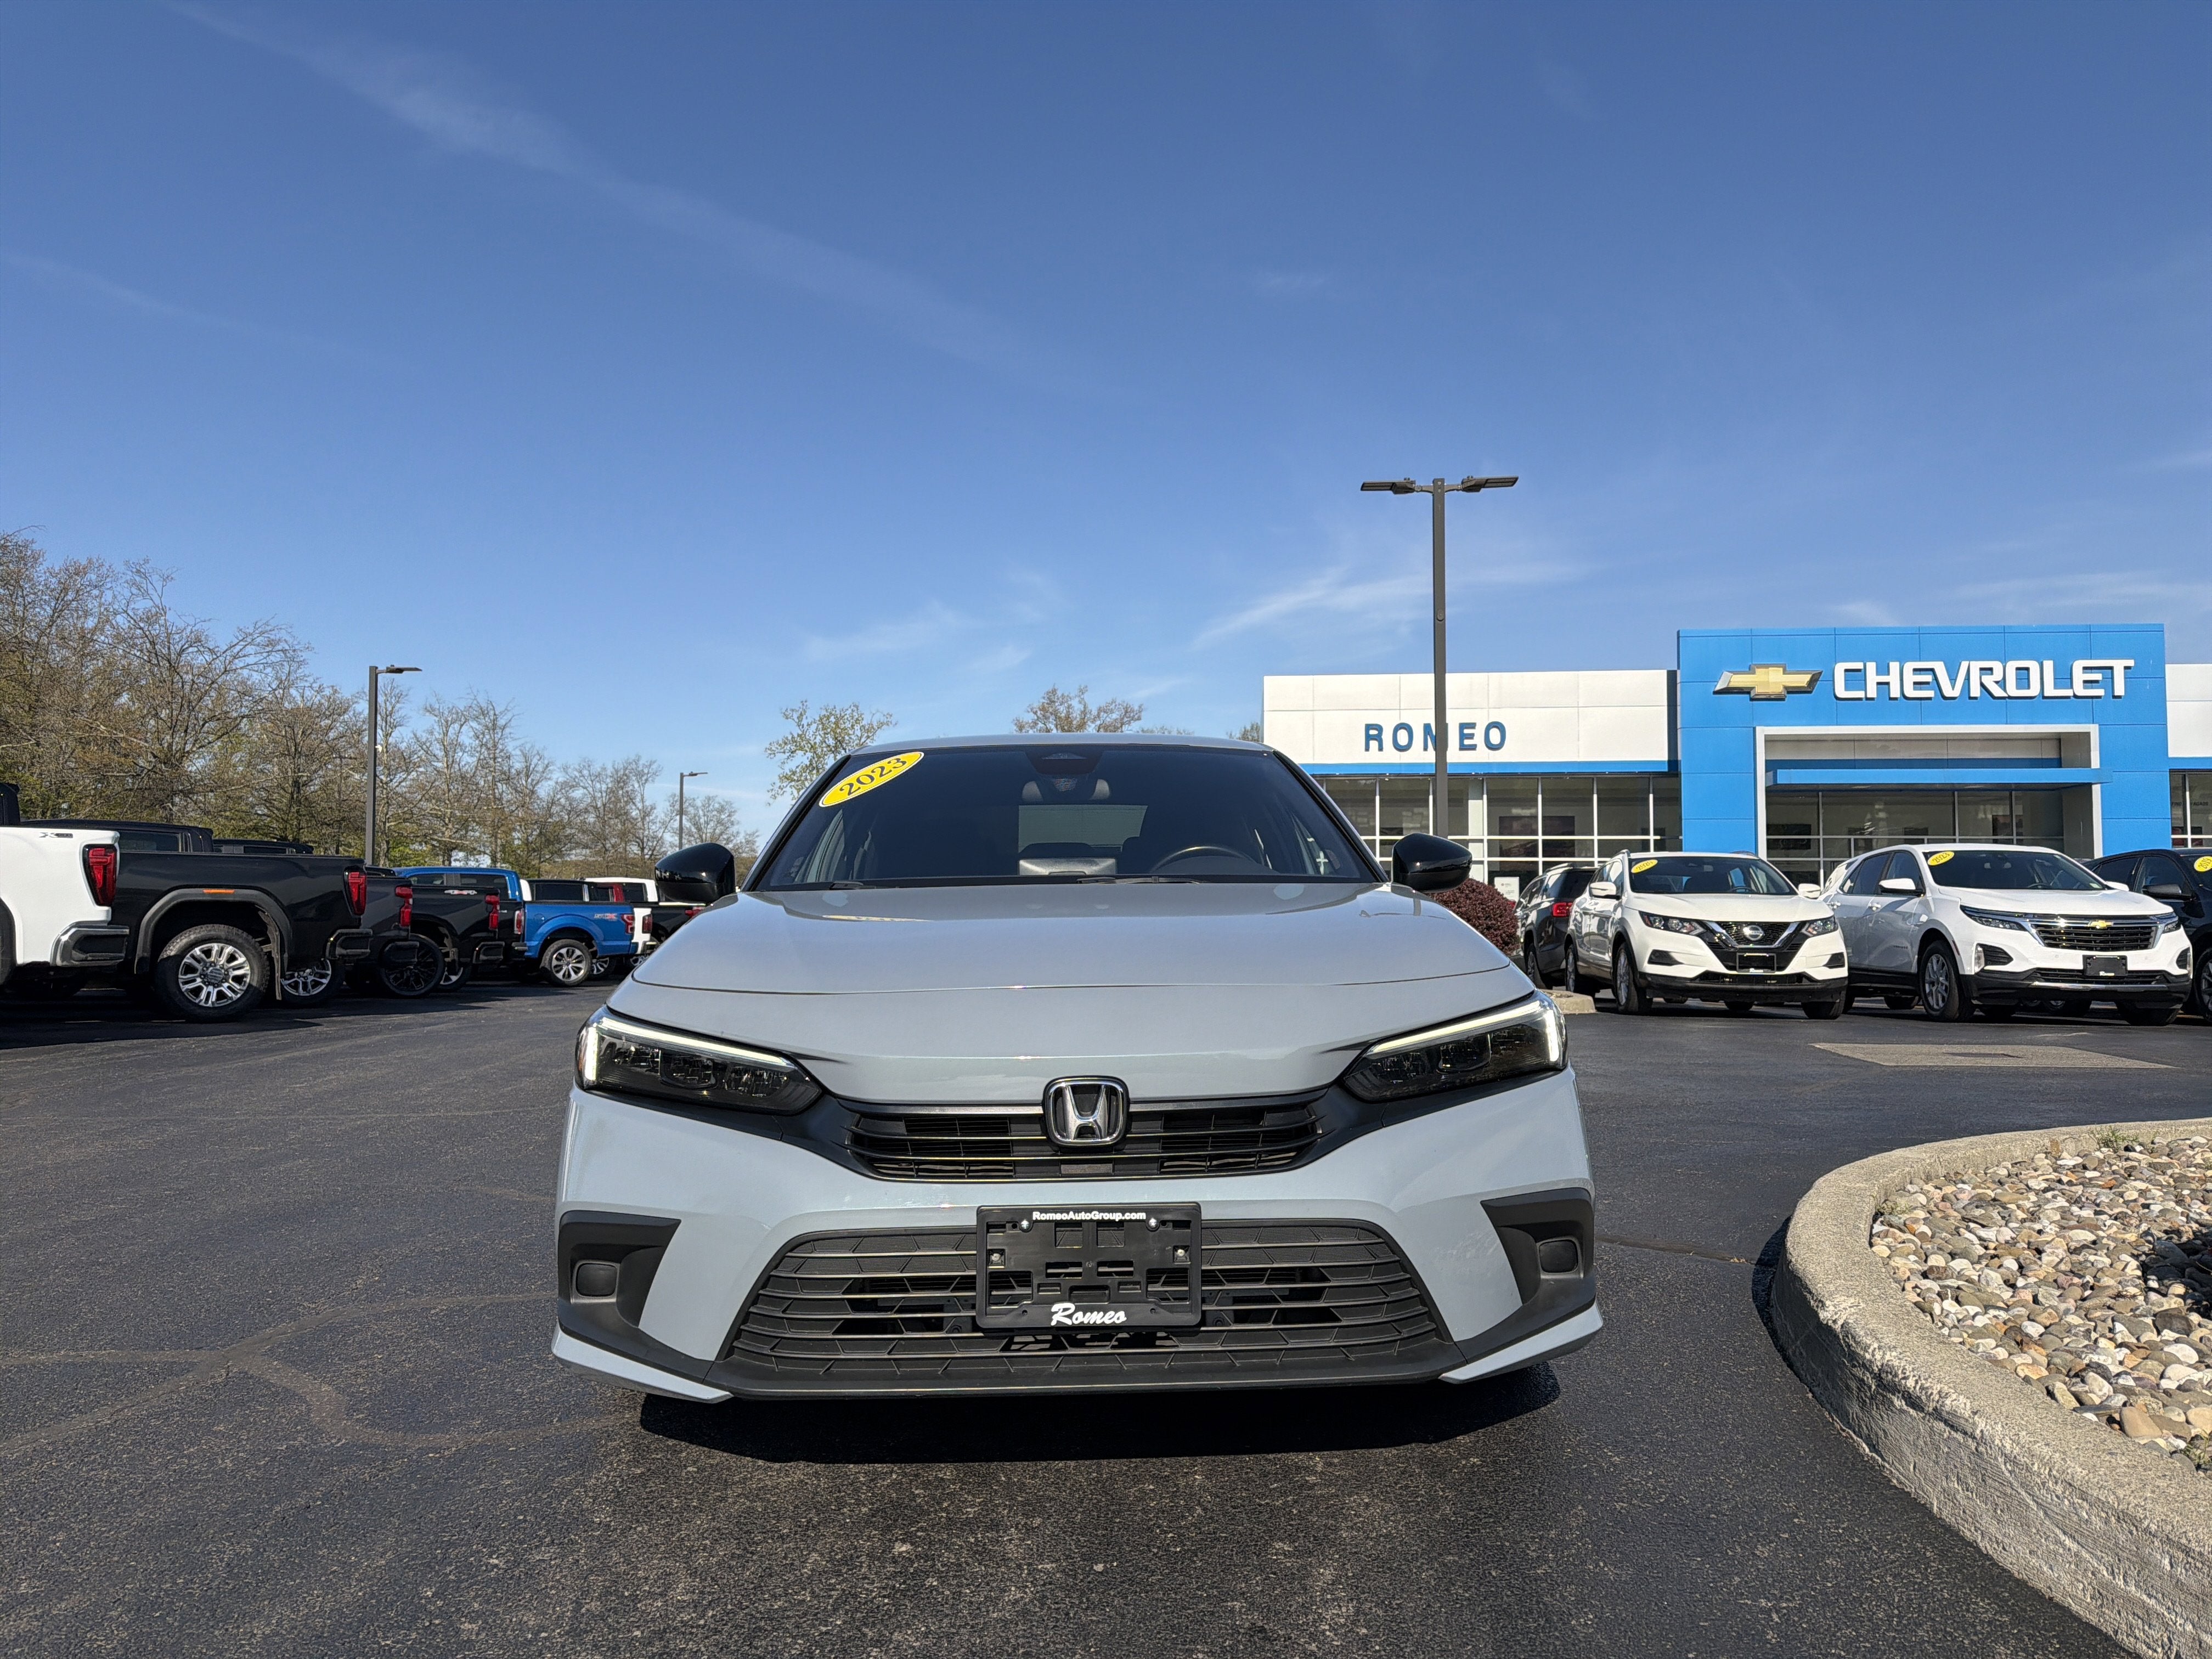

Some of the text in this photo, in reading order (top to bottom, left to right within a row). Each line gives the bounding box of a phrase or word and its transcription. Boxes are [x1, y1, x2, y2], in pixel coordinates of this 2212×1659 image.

[1834, 659, 2135, 699] CHEVROLET
[839, 758, 907, 795] 2023
[1932, 853, 1950, 863] 2023
[1032, 1211, 1147, 1221] RomeoAutoGroup.com
[1051, 1302, 1127, 1326] Romeo
